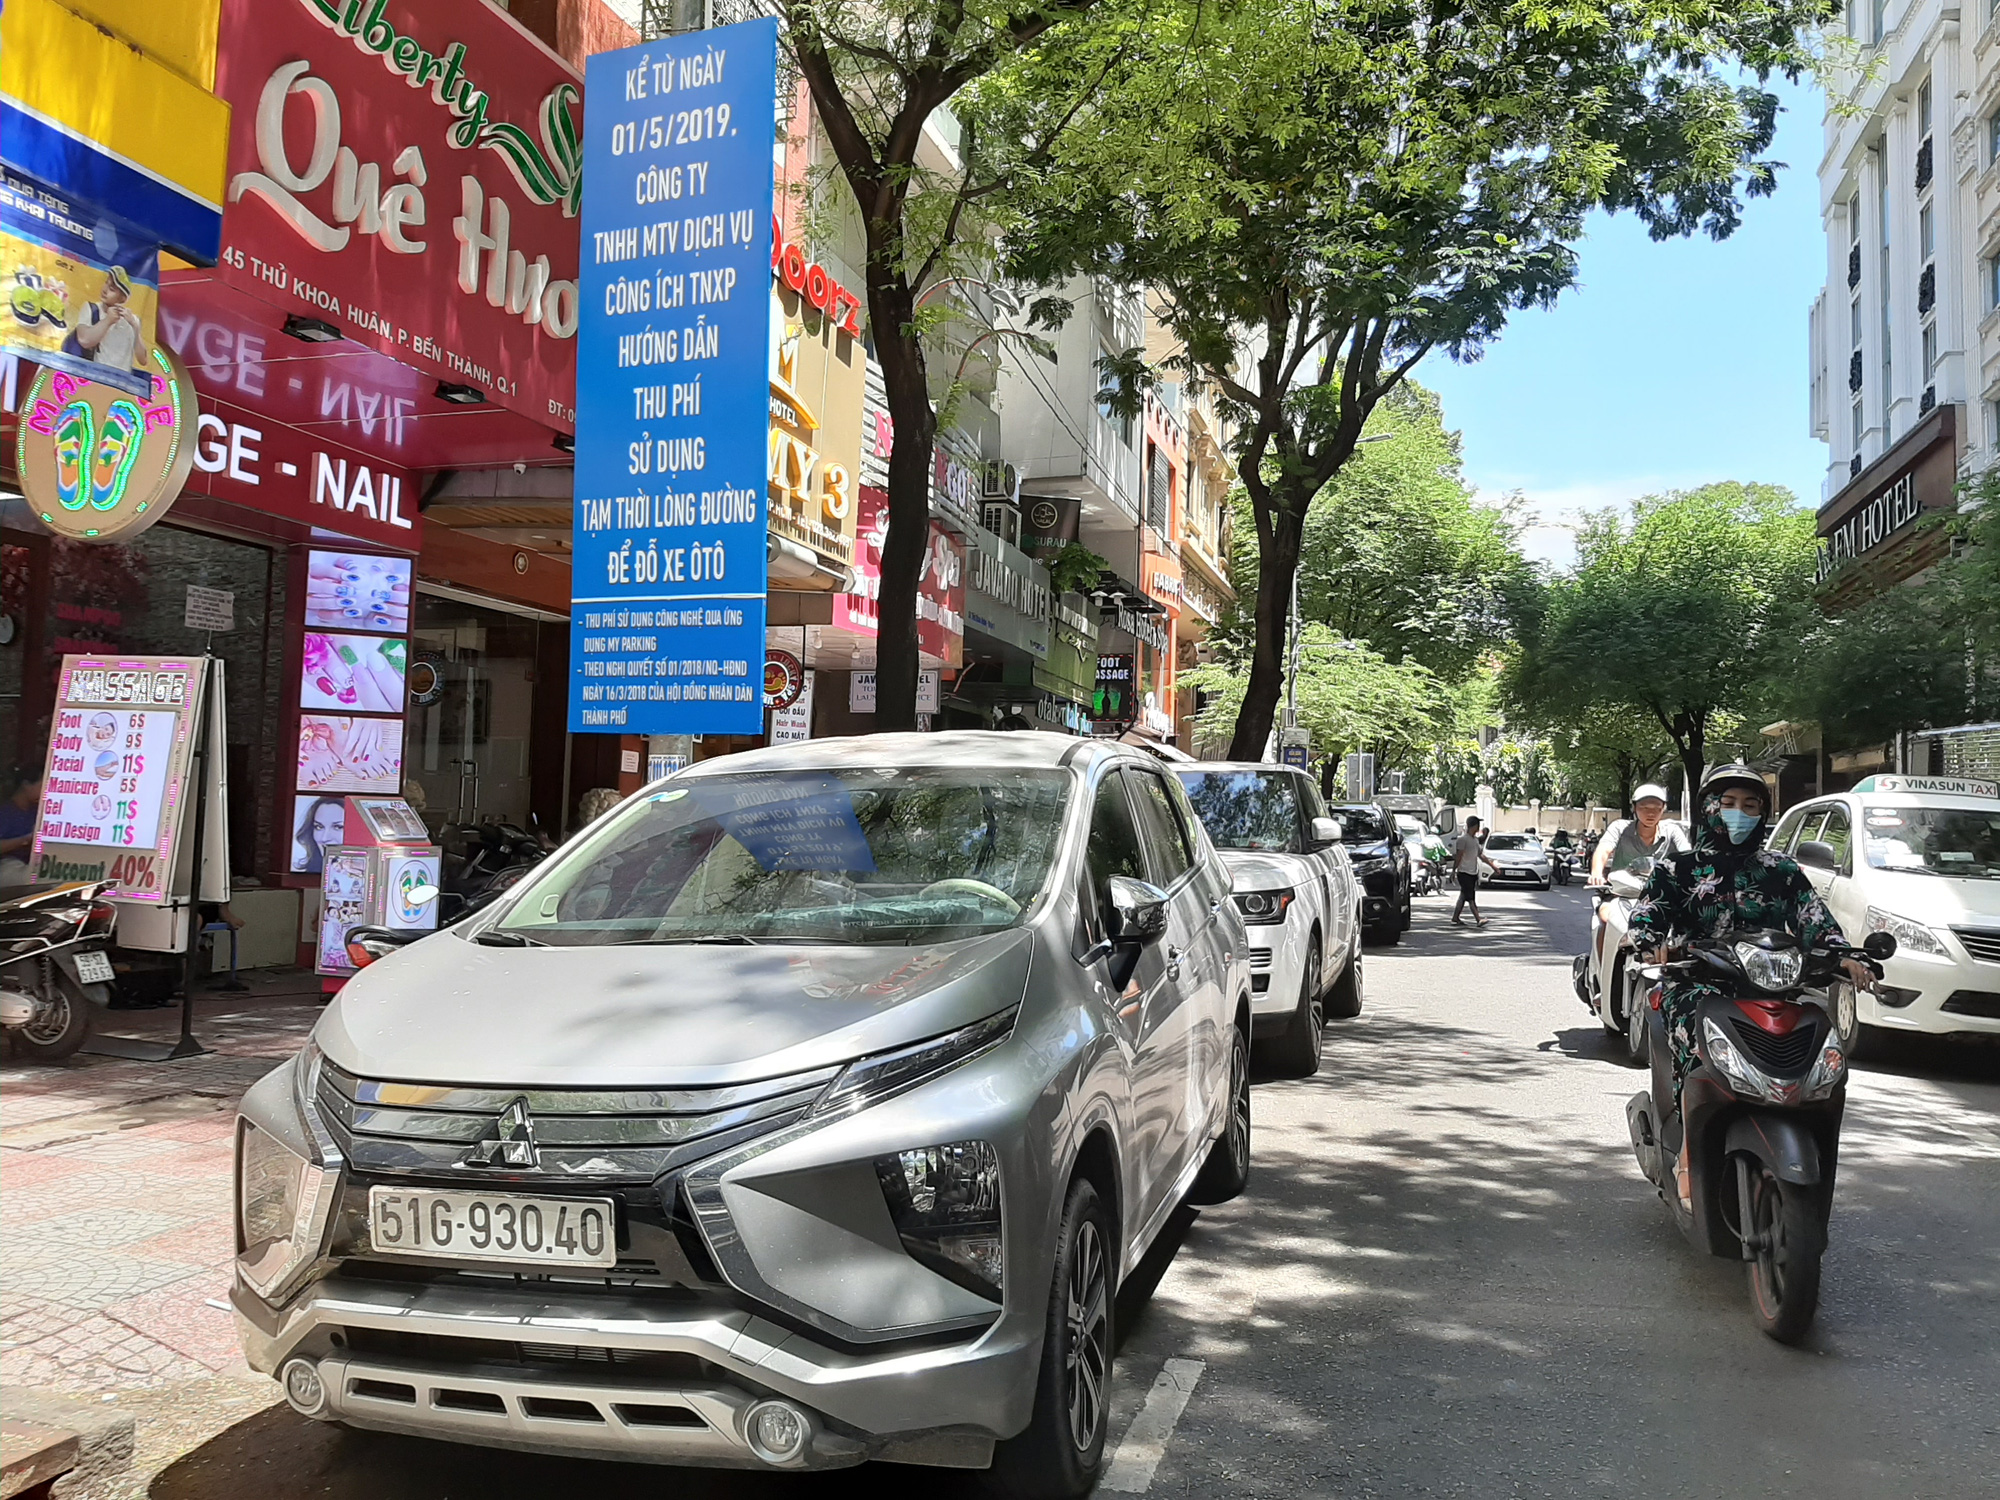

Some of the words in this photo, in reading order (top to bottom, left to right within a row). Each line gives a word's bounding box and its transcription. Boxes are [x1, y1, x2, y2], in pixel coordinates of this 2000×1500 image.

[626, 54, 647, 101] KỂ
[652, 53, 675, 95] TỪ
[680, 44, 726, 91] NGÀY
[612, 103, 737, 156] 01/5/2019.
[228, 60, 427, 253] Quê
[636, 164, 682, 205] CÔNG
[687, 161, 709, 196] TY
[594, 227, 638, 264] TNHH
[643, 220, 679, 257] MTV
[683, 213, 725, 257] DỊCH
[730, 209, 753, 250] VỤ
[605, 276, 650, 316] CÔNG
[656, 268, 684, 310] ÍCH
[689, 267, 736, 305] TNXP
[222, 246, 245, 270] 45
[250, 257, 288, 290] THỦ
[293, 277, 341, 316] KHOA
[347, 303, 395, 344] HUÂN,
[398, 328, 410, 347] P.
[413, 336, 442, 363] BẾN
[447, 350, 494, 390] THÀNH,
[618, 324, 678, 368] HƯỚNG
[683, 314, 719, 361] DẪN
[633, 385, 667, 420] THU
[672, 373, 701, 417] PHÍ
[628, 431, 652, 475] SỬ
[657, 436, 705, 479] DỤNG
[312, 451, 413, 529] NAIL
[582, 497, 611, 538] TẠM
[615, 487, 650, 529] THỜI
[654, 485, 695, 528] LÒNG
[700, 481, 756, 525] ĐƯỜNG
[821, 462, 851, 520] 3
[1861, 472, 1919, 552] HOTEL
[607, 538, 632, 584] ĐỂ
[635, 538, 658, 583] ĐỖ
[663, 548, 685, 582] XE
[690, 540, 725, 581] ÔTÔ
[1034, 536, 1067, 548] SURAU
[975, 550, 1018, 607] JAVADO
[585, 613, 600, 628] THU
[602, 608, 616, 628] PHÍ
[617, 607, 630, 628] SỬ
[631, 612, 654, 631] DỤNG
[655, 609, 678, 627] CÔNG
[680, 607, 703, 628] NGHỆ
[705, 610, 722, 626] QUA
[724, 606, 743, 627] ỨNG
[583, 637, 606, 655] DỤNG
[607, 637, 620, 652] MY
[621, 636, 657, 652] PARKING
[584, 661, 605, 677] THEO
[606, 660, 626, 679] NGHỊ
[627, 655, 654, 677] QUYẾT
[655, 656, 668, 676] SỐ
[66, 671, 187, 705] MASSAGE
[583, 683, 604, 701] NGÀY
[606, 684, 647, 701] 16/3/2018
[648, 681, 665, 701] CỦA
[667, 684, 681, 703] HỘI
[683, 680, 706, 701] ĐỒNG
[709, 683, 733, 701] NHÂN
[735, 683, 753, 702] DÂN
[59, 712, 82, 729] Foot
[582, 706, 608, 725] THÀNH
[610, 705, 628, 725] PHỐ
[52, 755, 84, 773] Facial
[56, 733, 83, 752] Body
[45, 799, 63, 816] Gel
[49, 777, 99, 796] Manicure
[1905, 778, 1965, 792] VINASUN
[1968, 783, 1997, 796] TAXI
[42, 821, 62, 838] Nail
[64, 821, 101, 842] Design
[39, 857, 105, 883] Discount
[109, 853, 155, 889] 40%
[380, 1198, 605, 1256] 51G-930.40
